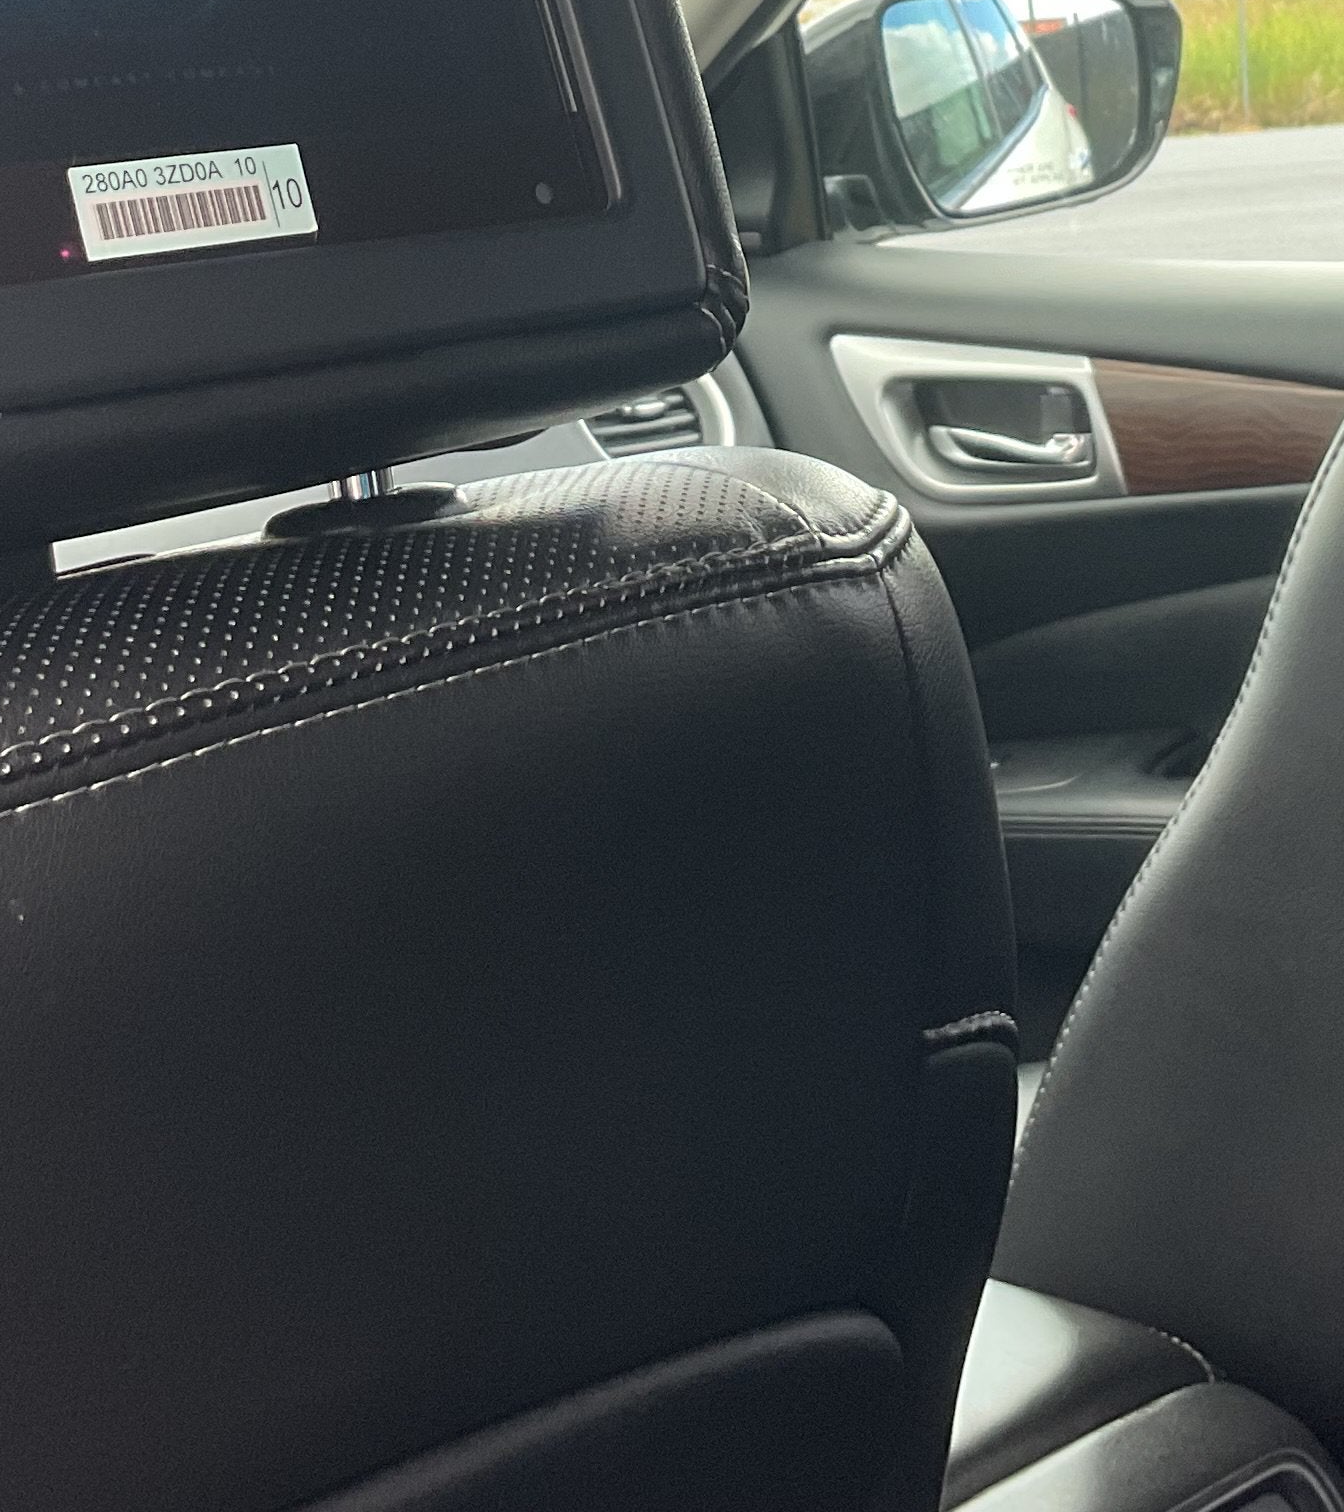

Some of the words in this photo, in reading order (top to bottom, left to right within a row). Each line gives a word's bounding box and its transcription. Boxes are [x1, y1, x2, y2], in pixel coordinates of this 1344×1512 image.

[82, 168, 148, 194] 280A0
[154, 160, 223, 186] 3ZD0A
[234, 156, 257, 176] 10
[272, 178, 304, 210] 10
